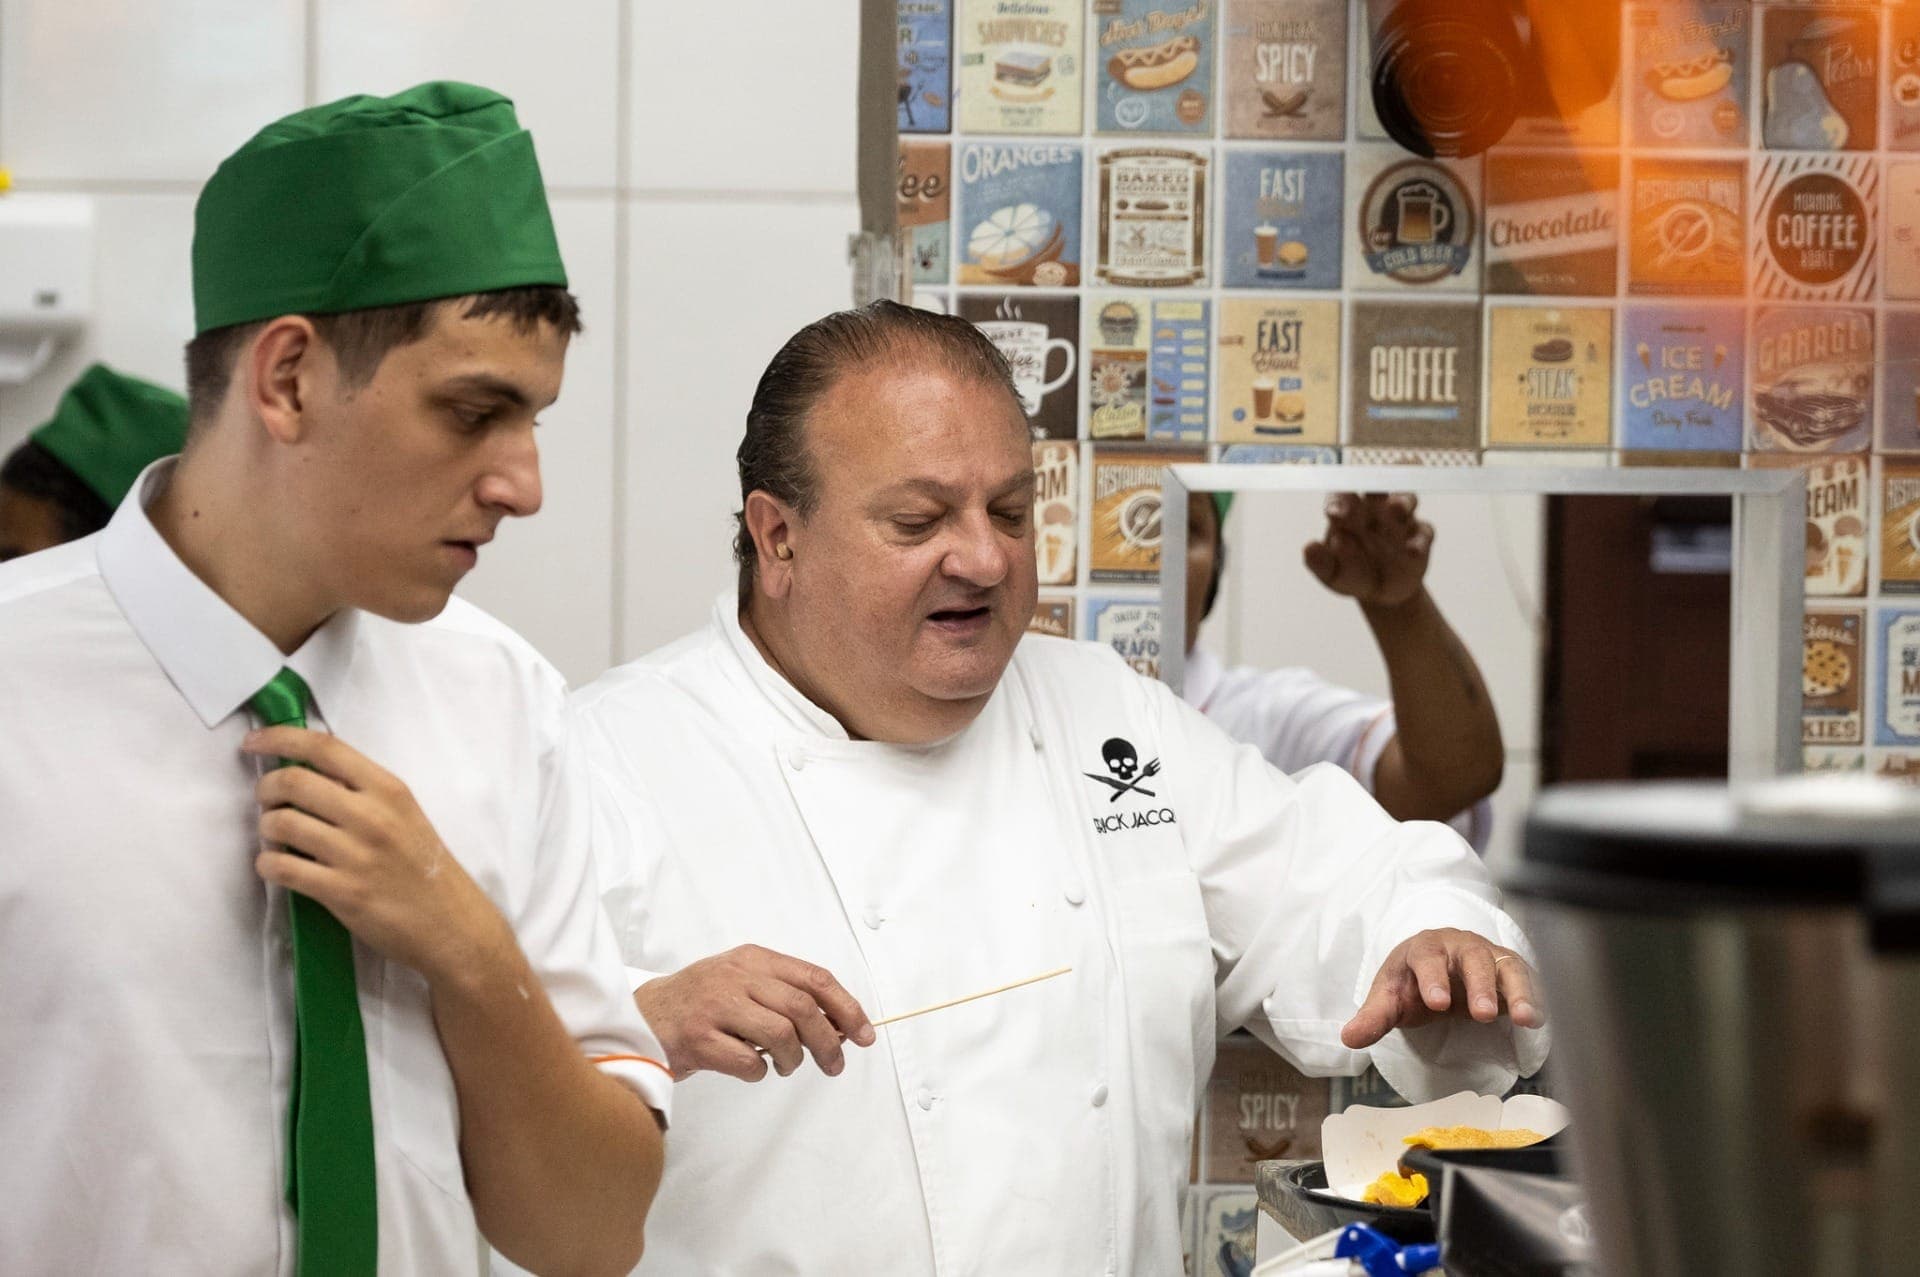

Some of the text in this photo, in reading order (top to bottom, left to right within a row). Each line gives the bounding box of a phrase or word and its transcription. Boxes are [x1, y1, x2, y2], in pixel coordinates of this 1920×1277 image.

[1255, 43, 1317, 84] SPICY
[962, 144, 1074, 184] ORANGES
[1259, 168, 1307, 202] FAST
[1489, 207, 1615, 248] Chocolate
[1776, 213, 1858, 250] COFFEE
[1256, 319, 1303, 354] FAST
[1369, 345, 1459, 402] COFFEE
[1661, 346, 1704, 371] ICE
[1526, 367, 1577, 401] STEAK
[1630, 374, 1734, 412] CREAM
[1131, 807, 1176, 829] JACQ
[1238, 1092, 1299, 1131] SPICY
